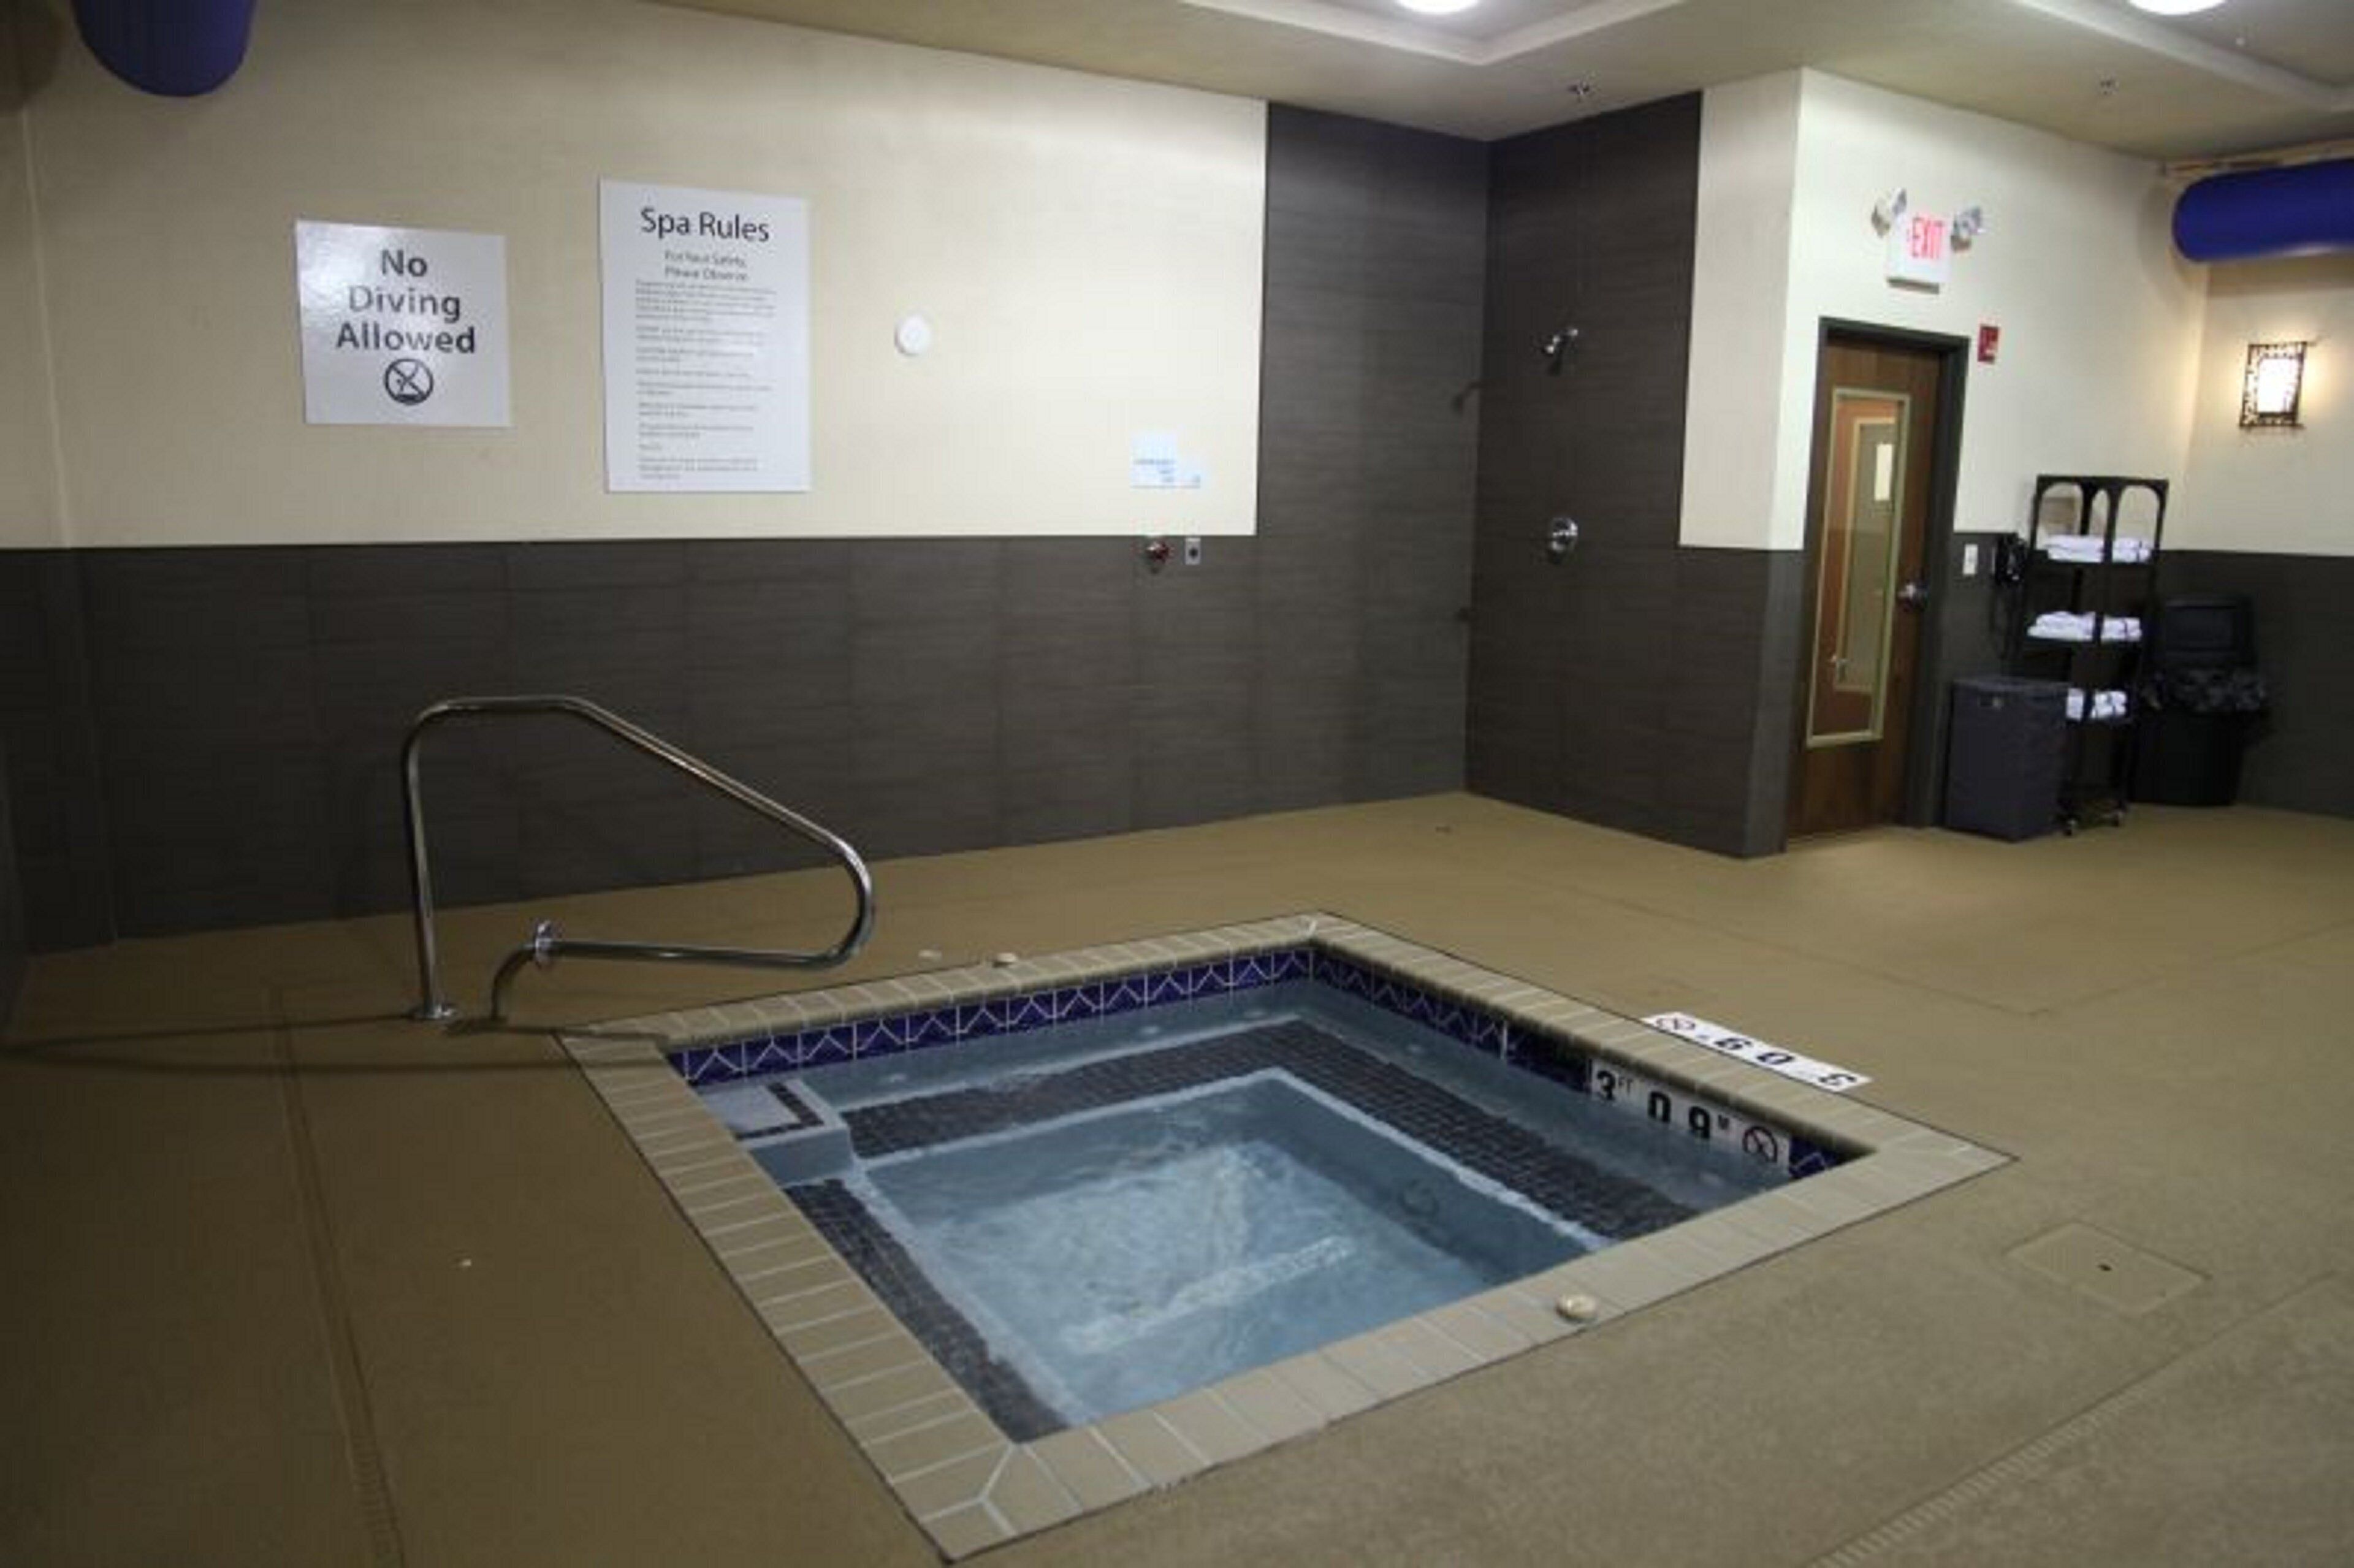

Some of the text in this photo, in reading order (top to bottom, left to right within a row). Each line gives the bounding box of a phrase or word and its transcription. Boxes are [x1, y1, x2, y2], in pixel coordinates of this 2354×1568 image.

[641, 206, 770, 242] Spa Rules
[1911, 215, 1945, 260] EXIT
[380, 249, 428, 277] No
[348, 285, 460, 324] Diving
[335, 321, 476, 354] Allowed
